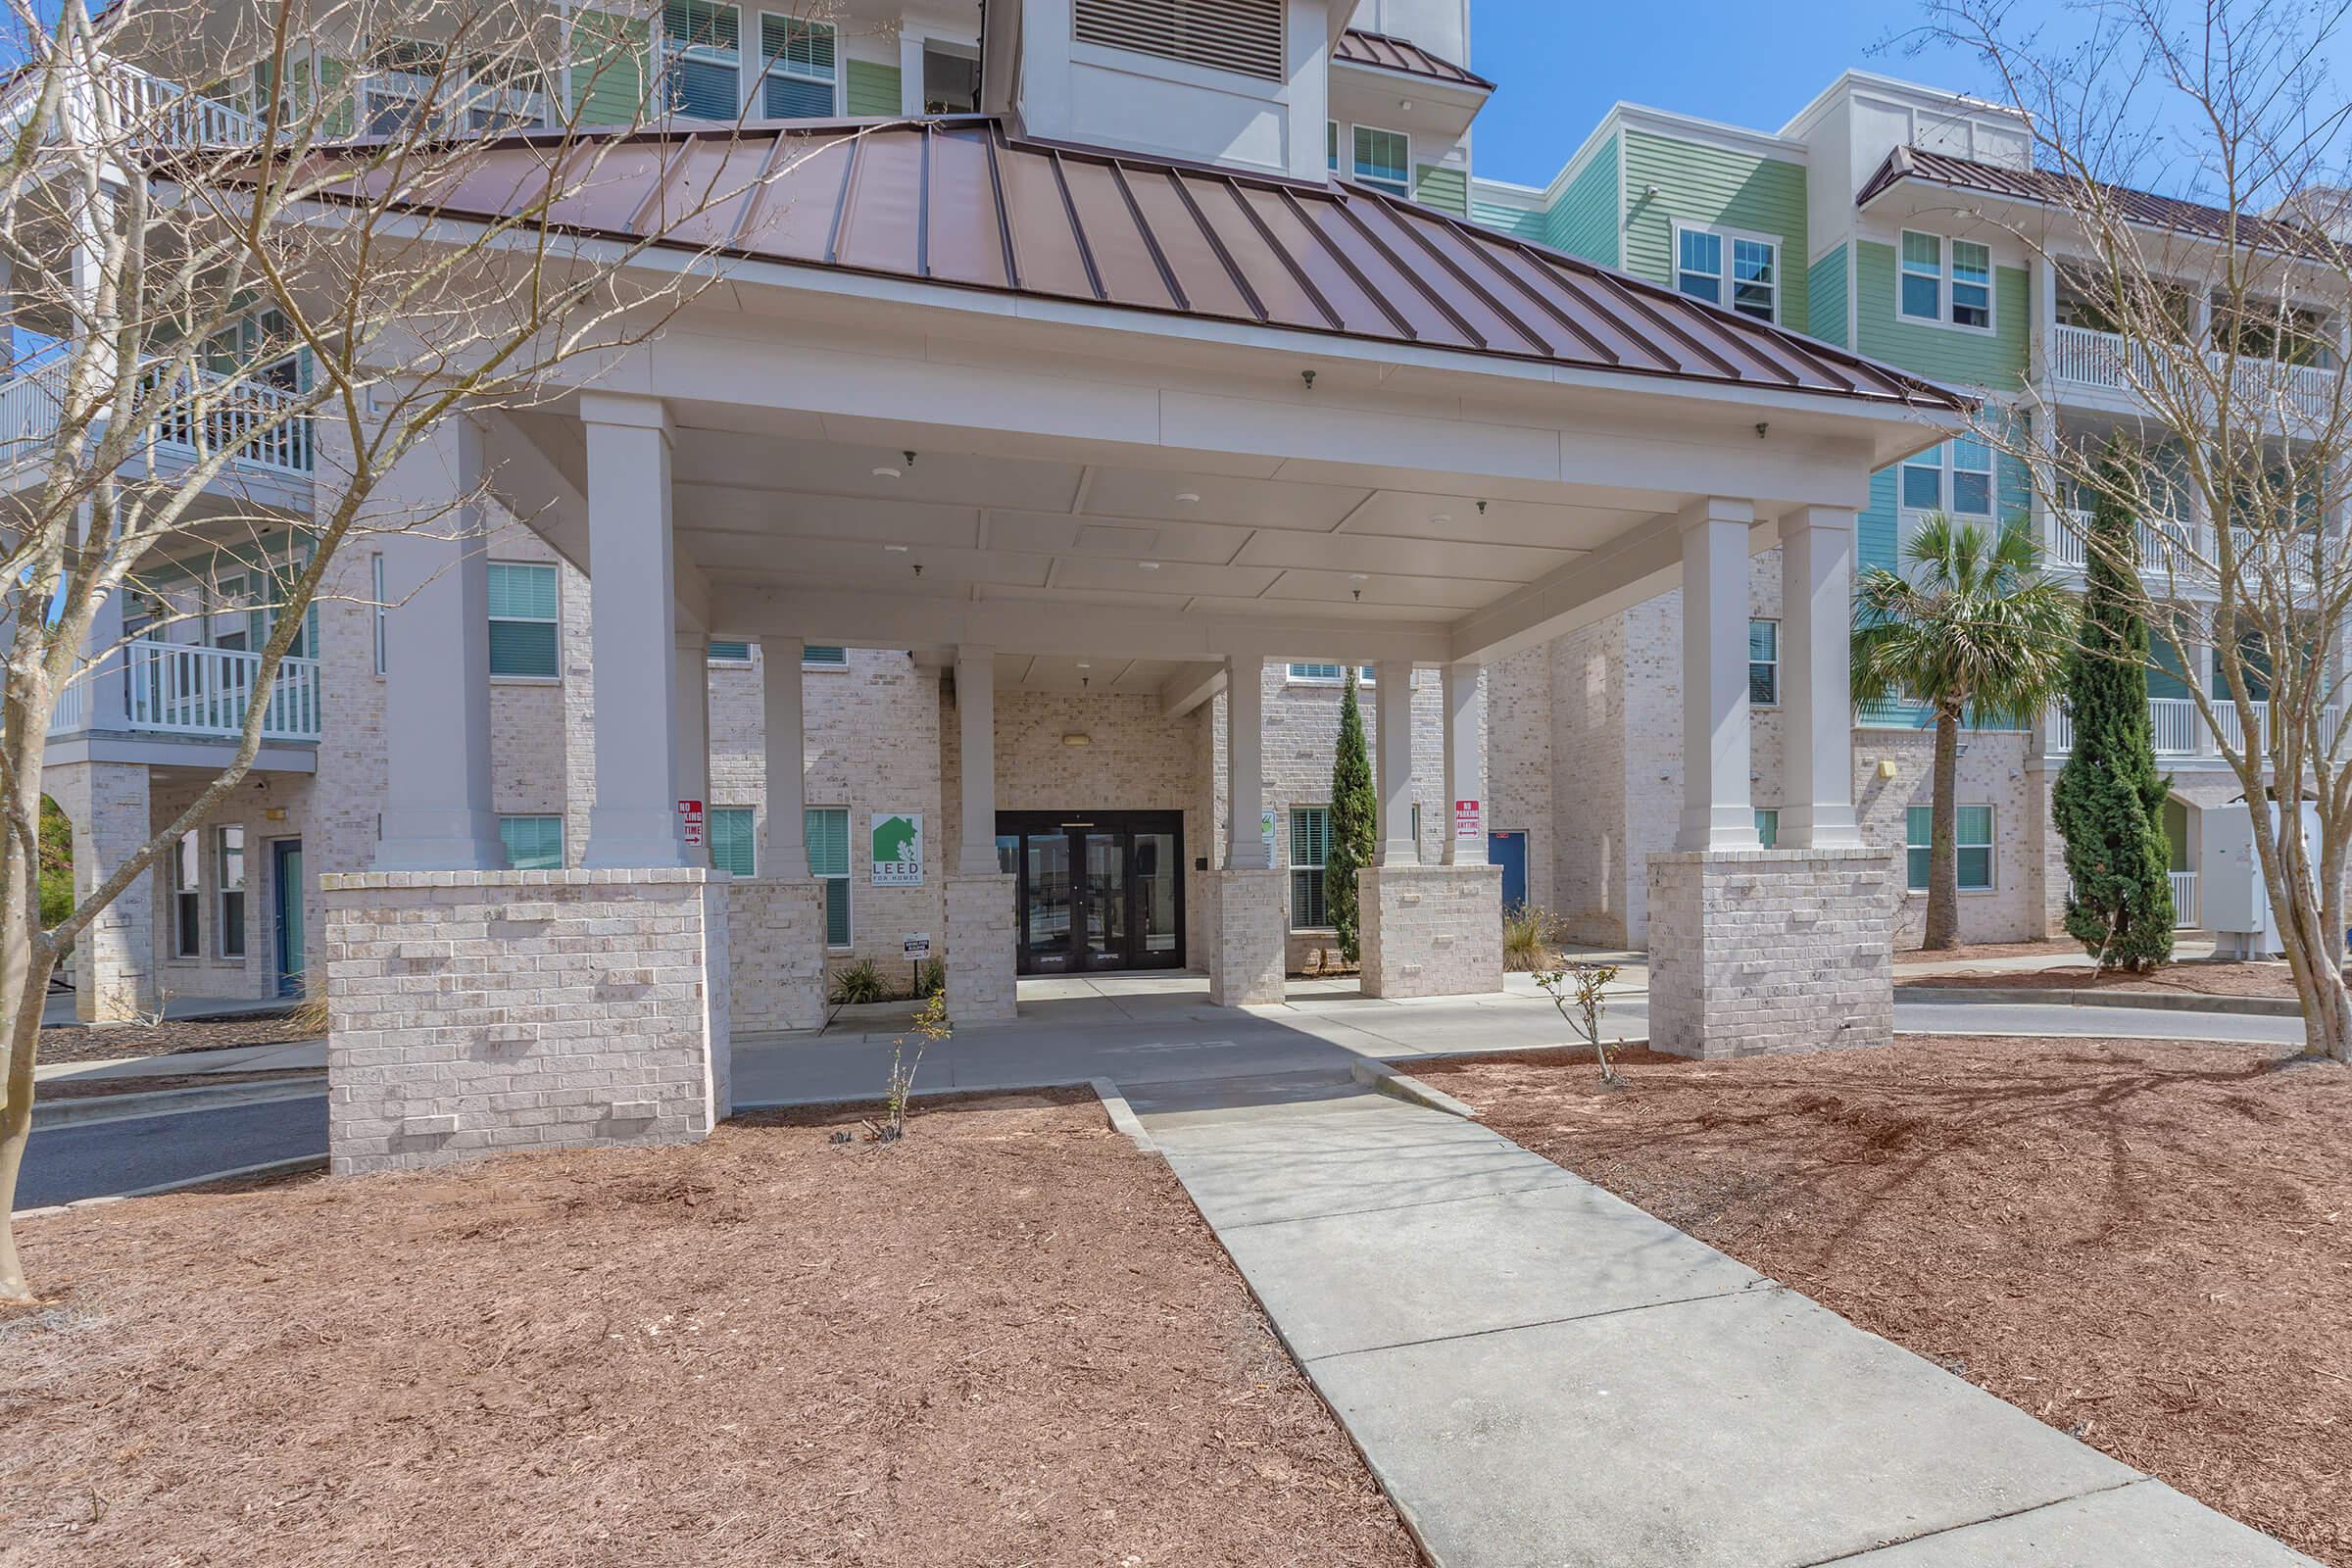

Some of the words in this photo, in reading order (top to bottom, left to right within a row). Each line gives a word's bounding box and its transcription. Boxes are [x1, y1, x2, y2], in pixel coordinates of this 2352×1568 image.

[680, 802, 690, 811] NO
[684, 811, 702, 821] KING
[684, 826, 702, 834] TIME
[873, 863, 918, 874] LEED
